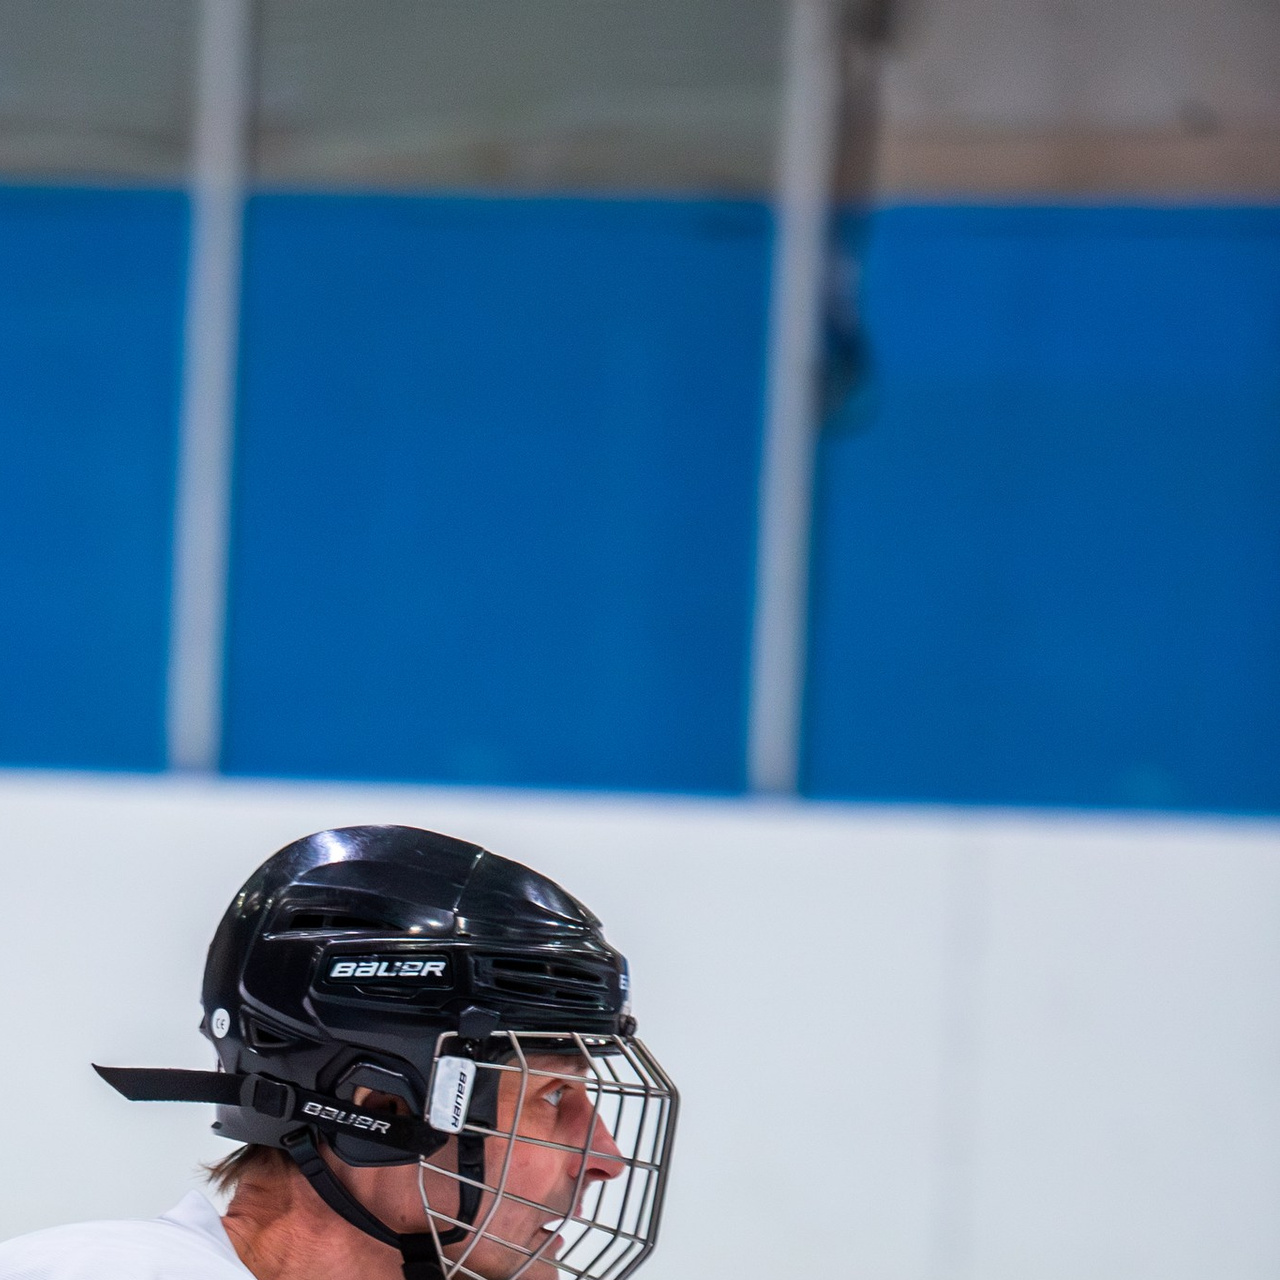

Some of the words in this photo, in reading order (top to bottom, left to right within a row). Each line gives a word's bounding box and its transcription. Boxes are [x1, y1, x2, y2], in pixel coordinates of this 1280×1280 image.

[329, 961, 447, 978] BAUER
[450, 1071, 468, 1129] BAUER
[302, 1101, 392, 1135] BAUER
